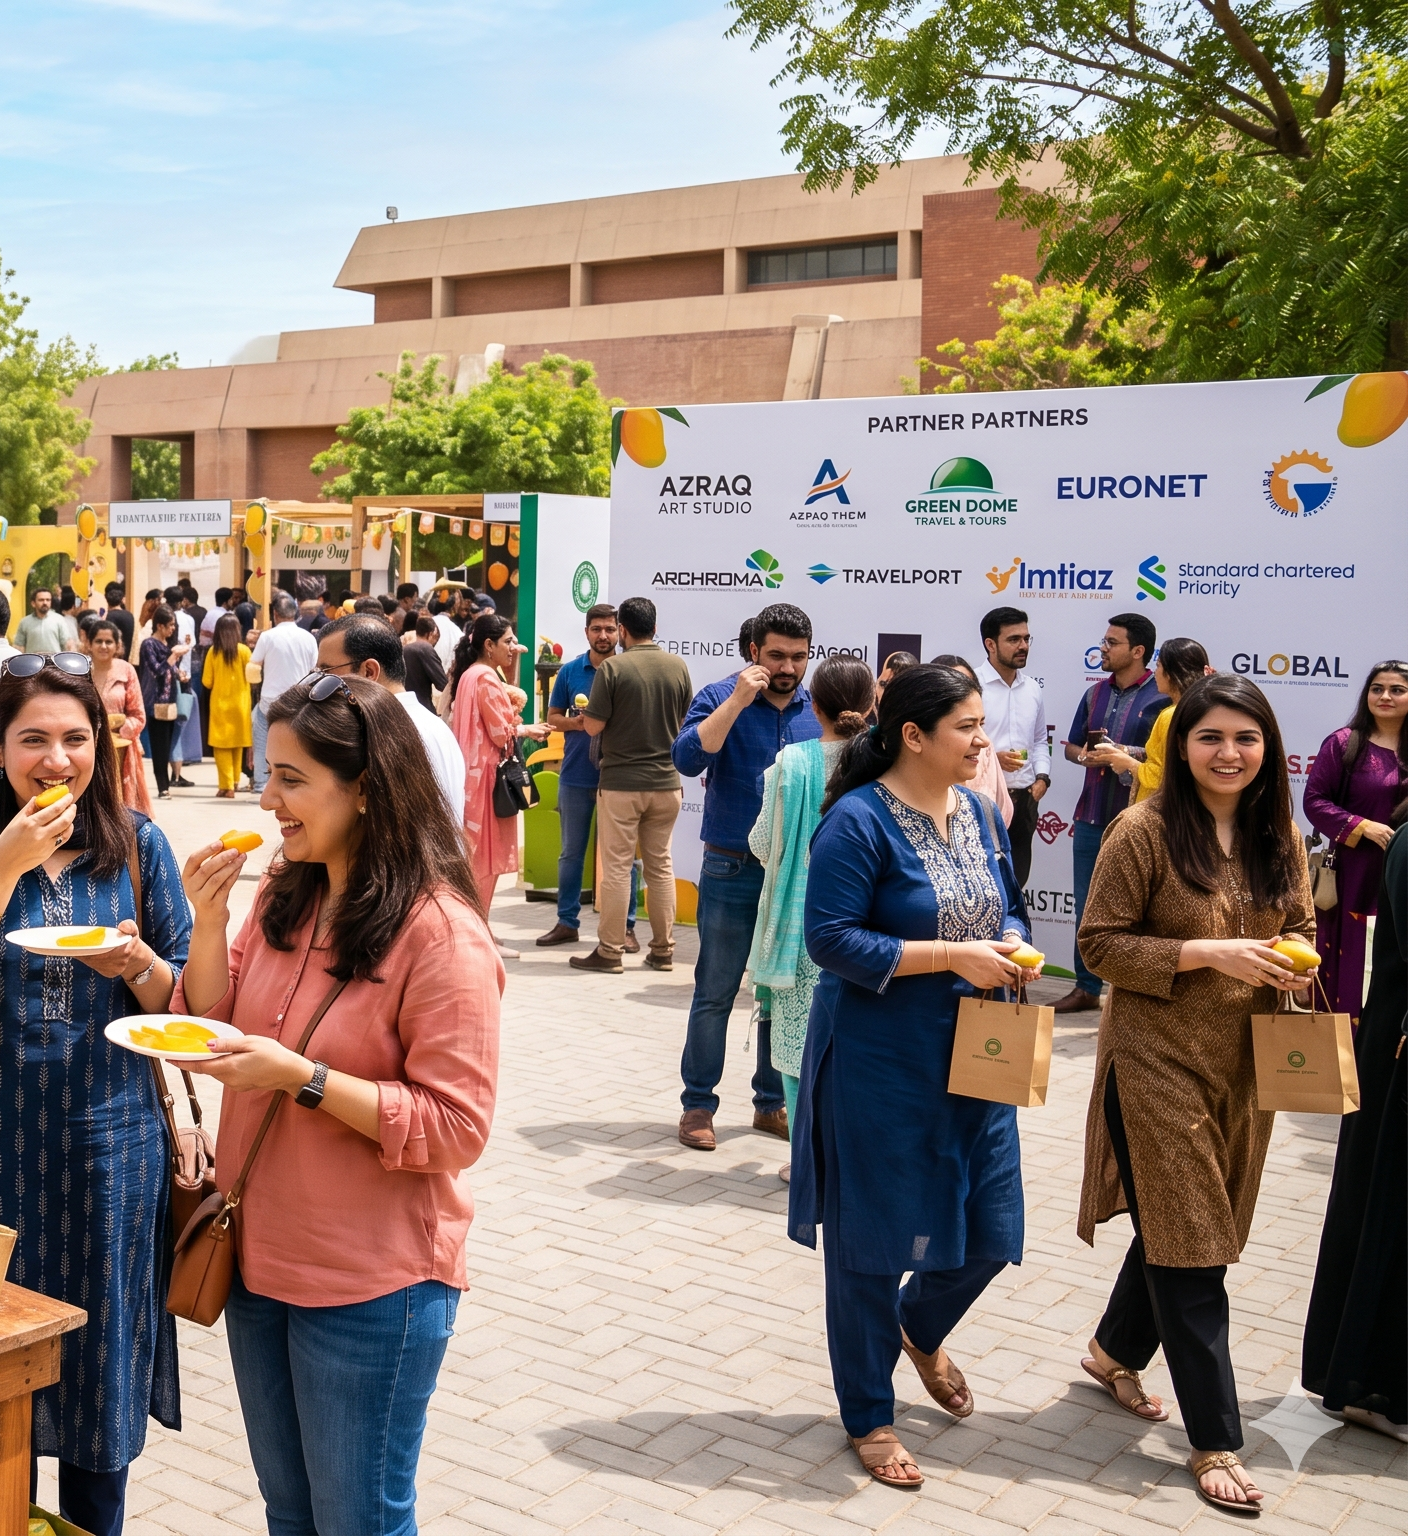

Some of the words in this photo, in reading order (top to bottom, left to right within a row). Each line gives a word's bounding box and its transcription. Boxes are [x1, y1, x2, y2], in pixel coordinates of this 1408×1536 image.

[868, 413, 965, 433] PARTNER
[972, 408, 1089, 429] PARTNERS
[659, 474, 752, 497] AZRAQ
[1057, 474, 1208, 500] EURONET
[658, 502, 688, 514] ART
[693, 501, 752, 514] STUDIO
[905, 499, 961, 513] GREEN
[966, 498, 1018, 513] DOME
[789, 511, 829, 521] AZPAQ
[915, 516, 956, 526] TRAVEL
[958, 517, 966, 526] &
[969, 516, 1007, 526] TOURS
[651, 571, 764, 587] ARCHROMA
[842, 569, 962, 585] TRAVELPORT
[1019, 562, 1114, 590] Imtiaz
[1263, 563, 1355, 579] chartered
[1178, 580, 1241, 599] Priority
[1231, 652, 1349, 678] GLOBAL
